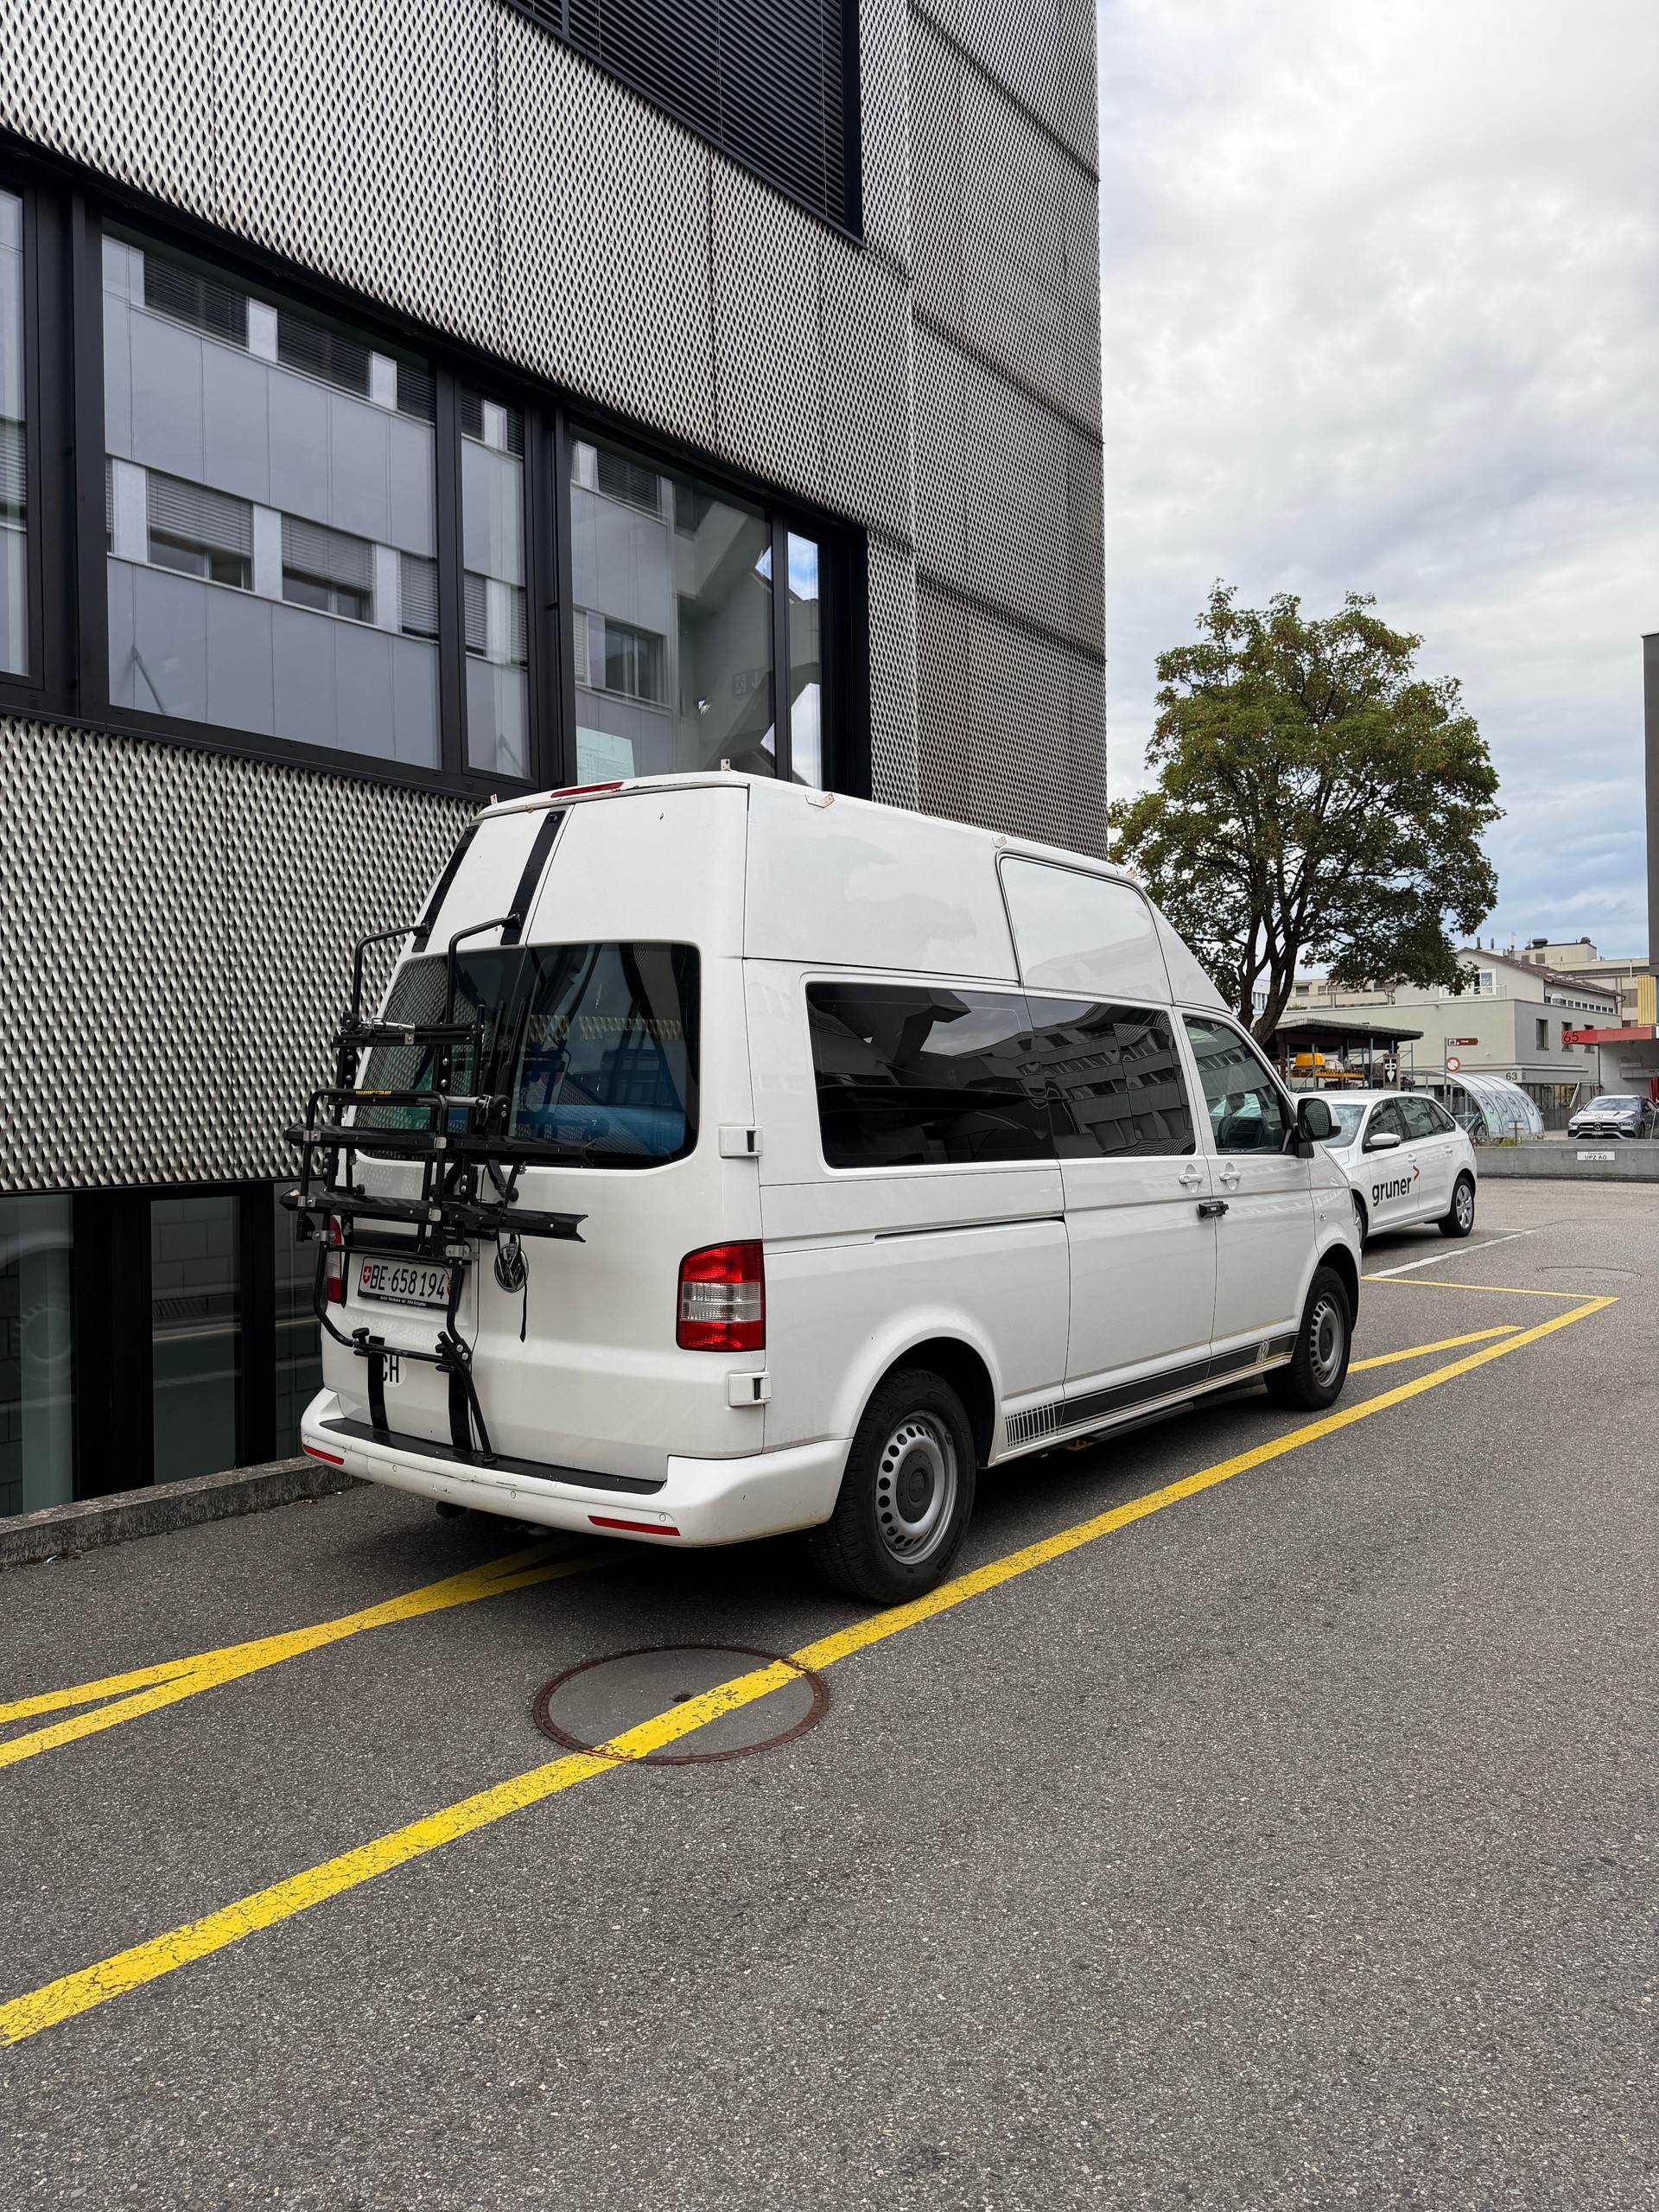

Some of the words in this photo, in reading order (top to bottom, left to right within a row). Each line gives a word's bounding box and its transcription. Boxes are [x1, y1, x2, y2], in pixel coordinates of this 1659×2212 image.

[1563, 1031, 1580, 1042] 65
[1505, 1072, 1518, 1081] 63
[1371, 1177, 1412, 1207] gruner
